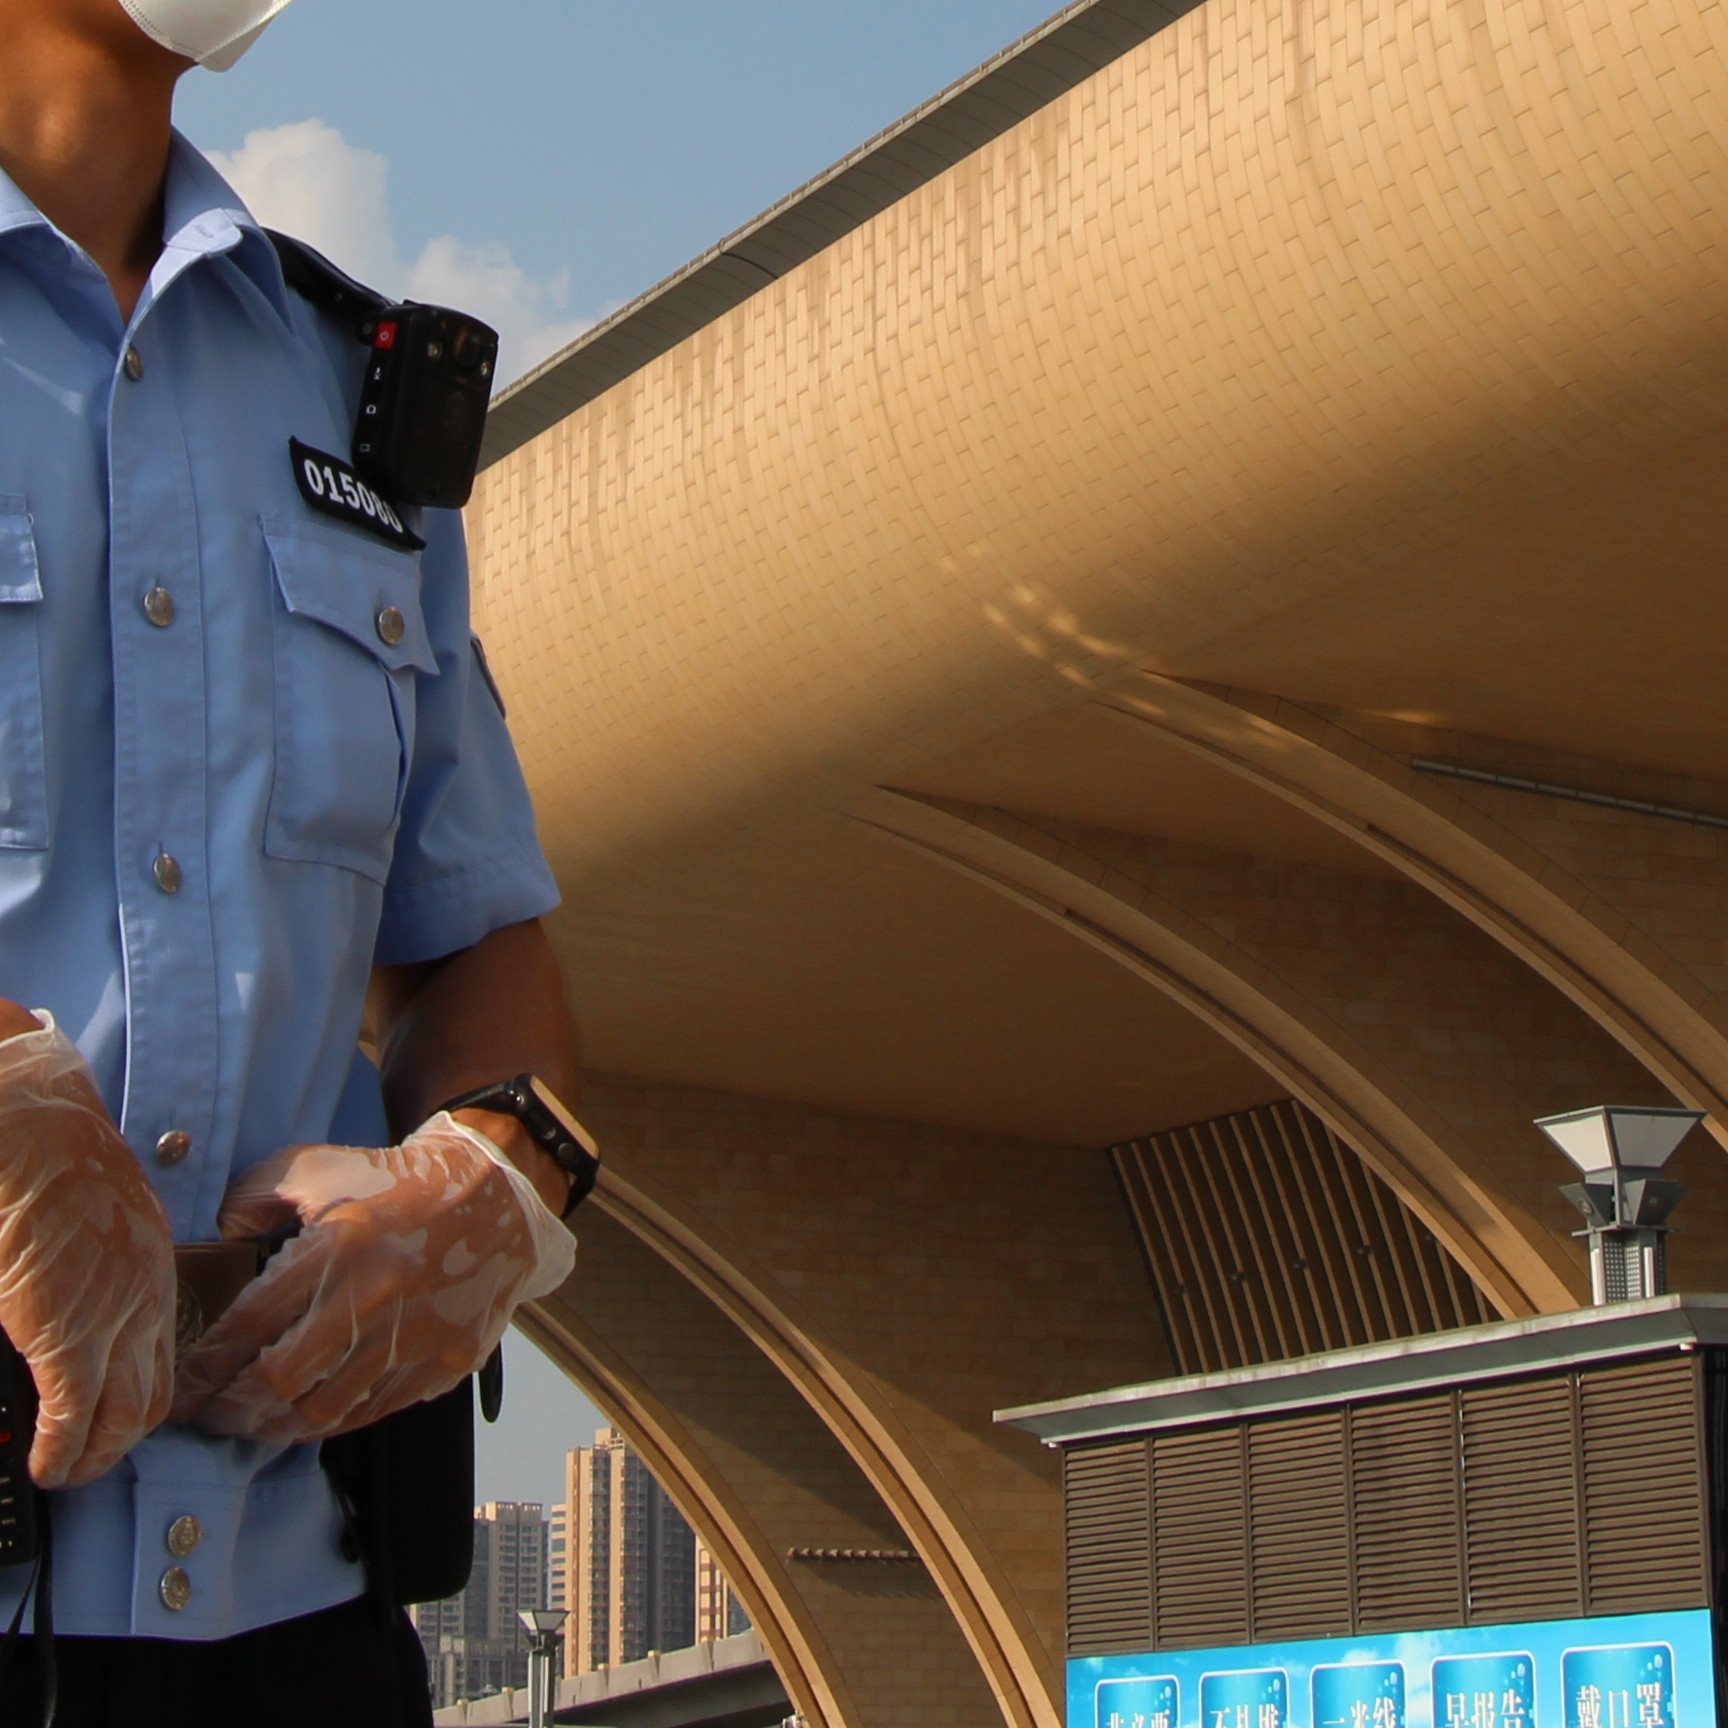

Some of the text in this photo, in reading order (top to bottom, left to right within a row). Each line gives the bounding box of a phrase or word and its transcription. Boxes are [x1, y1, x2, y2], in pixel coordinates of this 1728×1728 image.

[303, 458, 404, 534] 015080
[1575, 1681, 1665, 1728] 戴口罩
